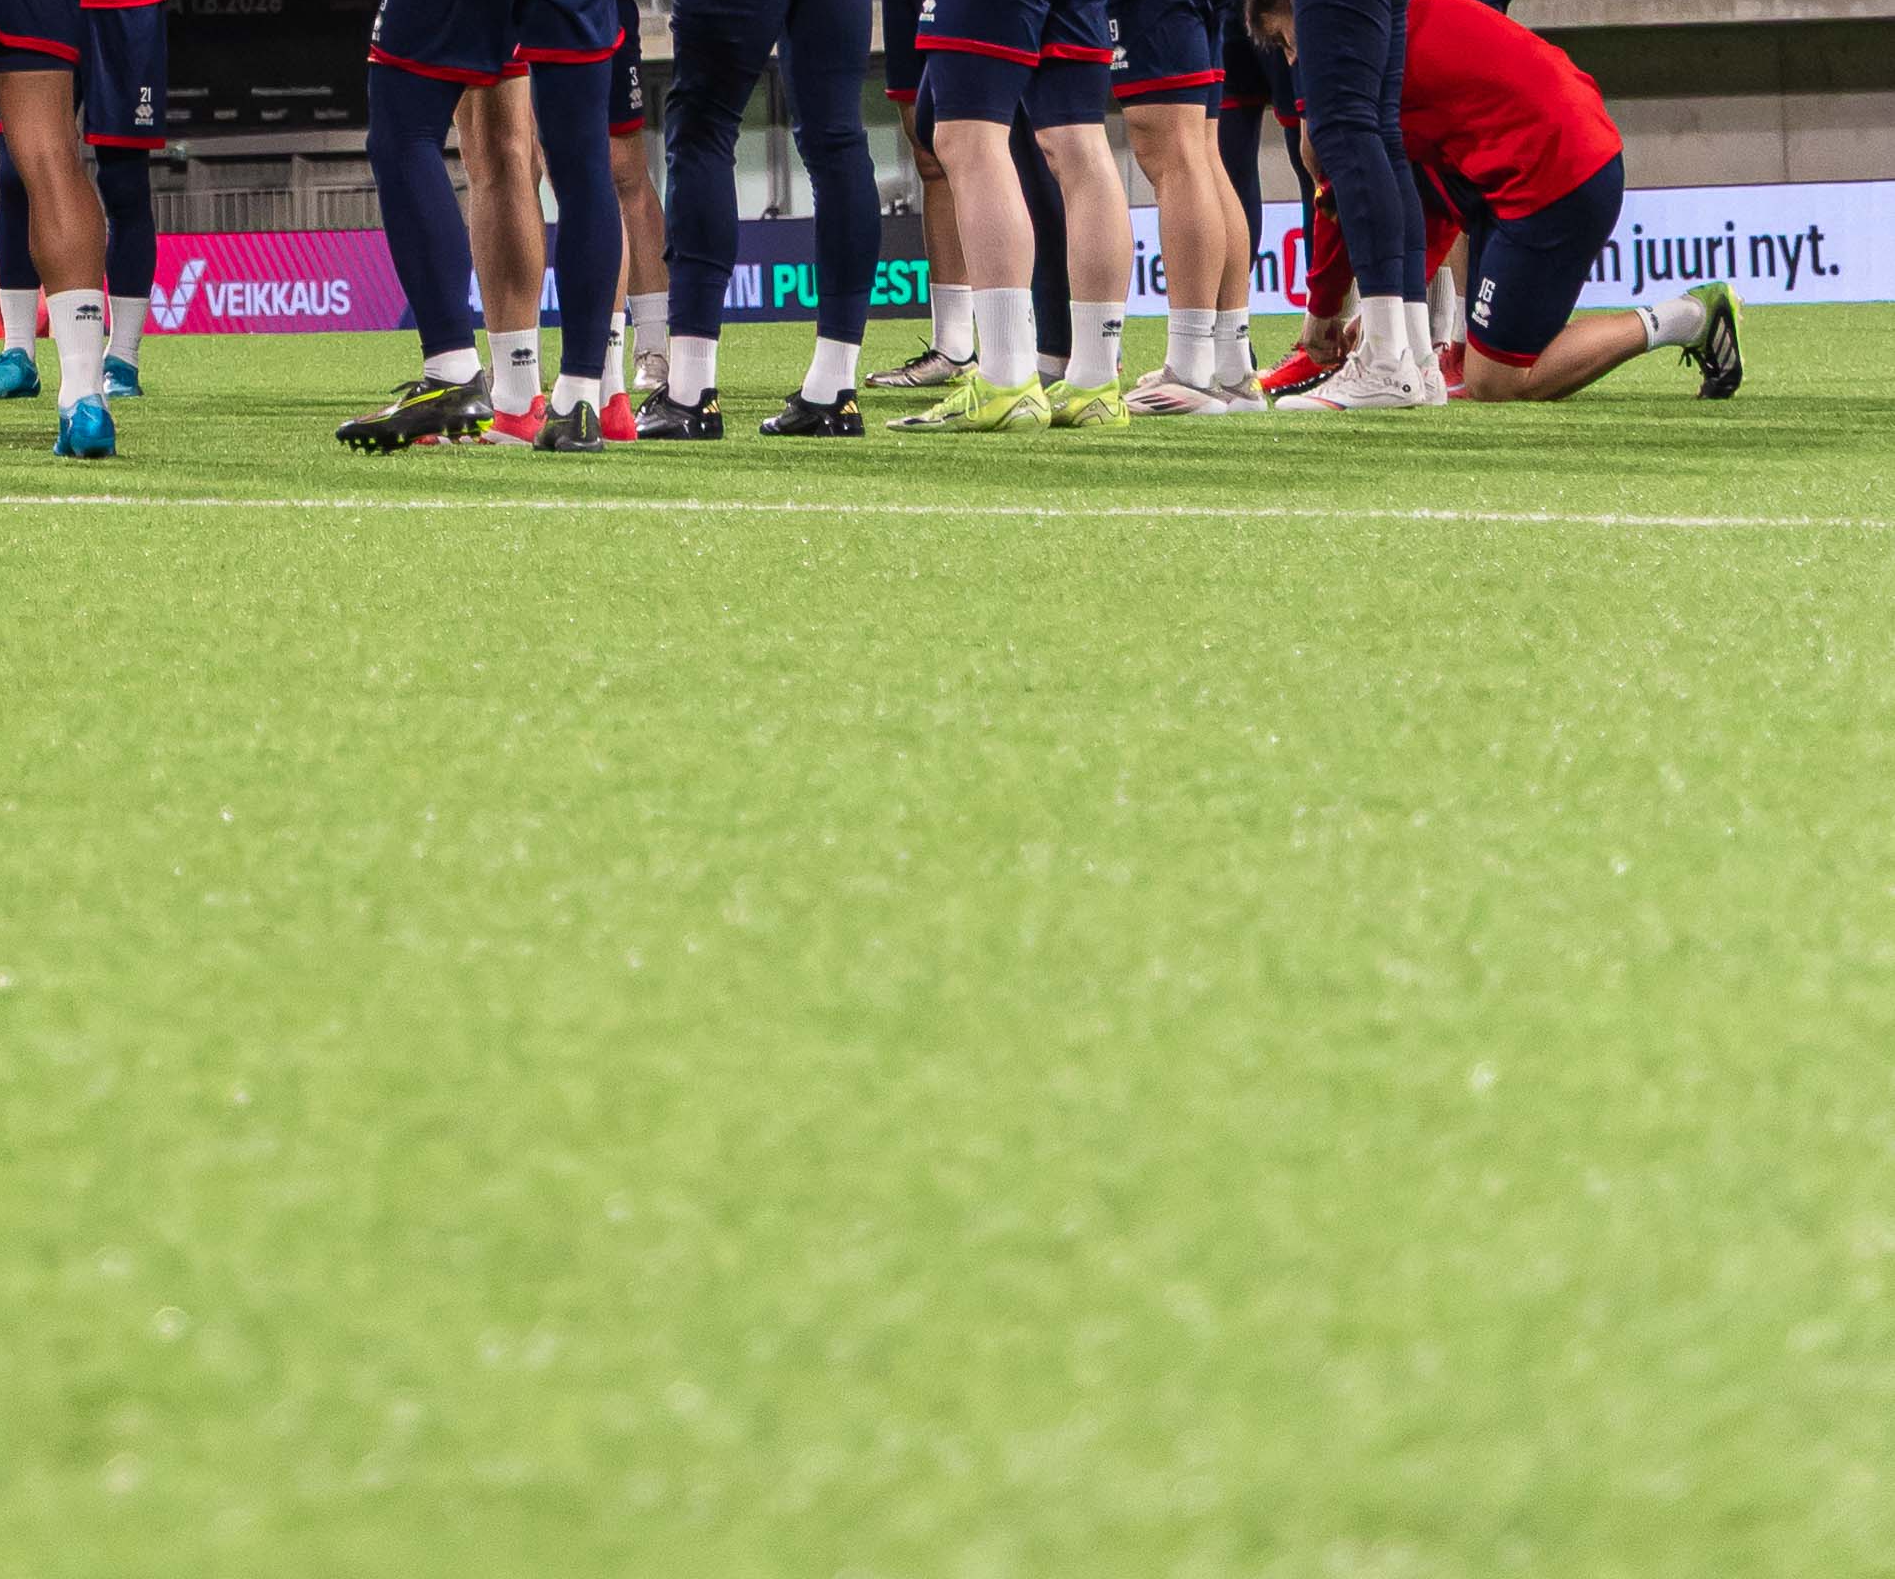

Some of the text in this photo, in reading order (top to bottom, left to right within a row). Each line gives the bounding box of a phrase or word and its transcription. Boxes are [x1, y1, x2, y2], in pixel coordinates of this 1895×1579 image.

[140, 86, 152, 103] 21
[1631, 222, 1737, 296] juuri
[1749, 225, 1840, 291] nyt.
[206, 279, 351, 317] VEIKKAUS
[1477, 277, 1496, 303] 16
